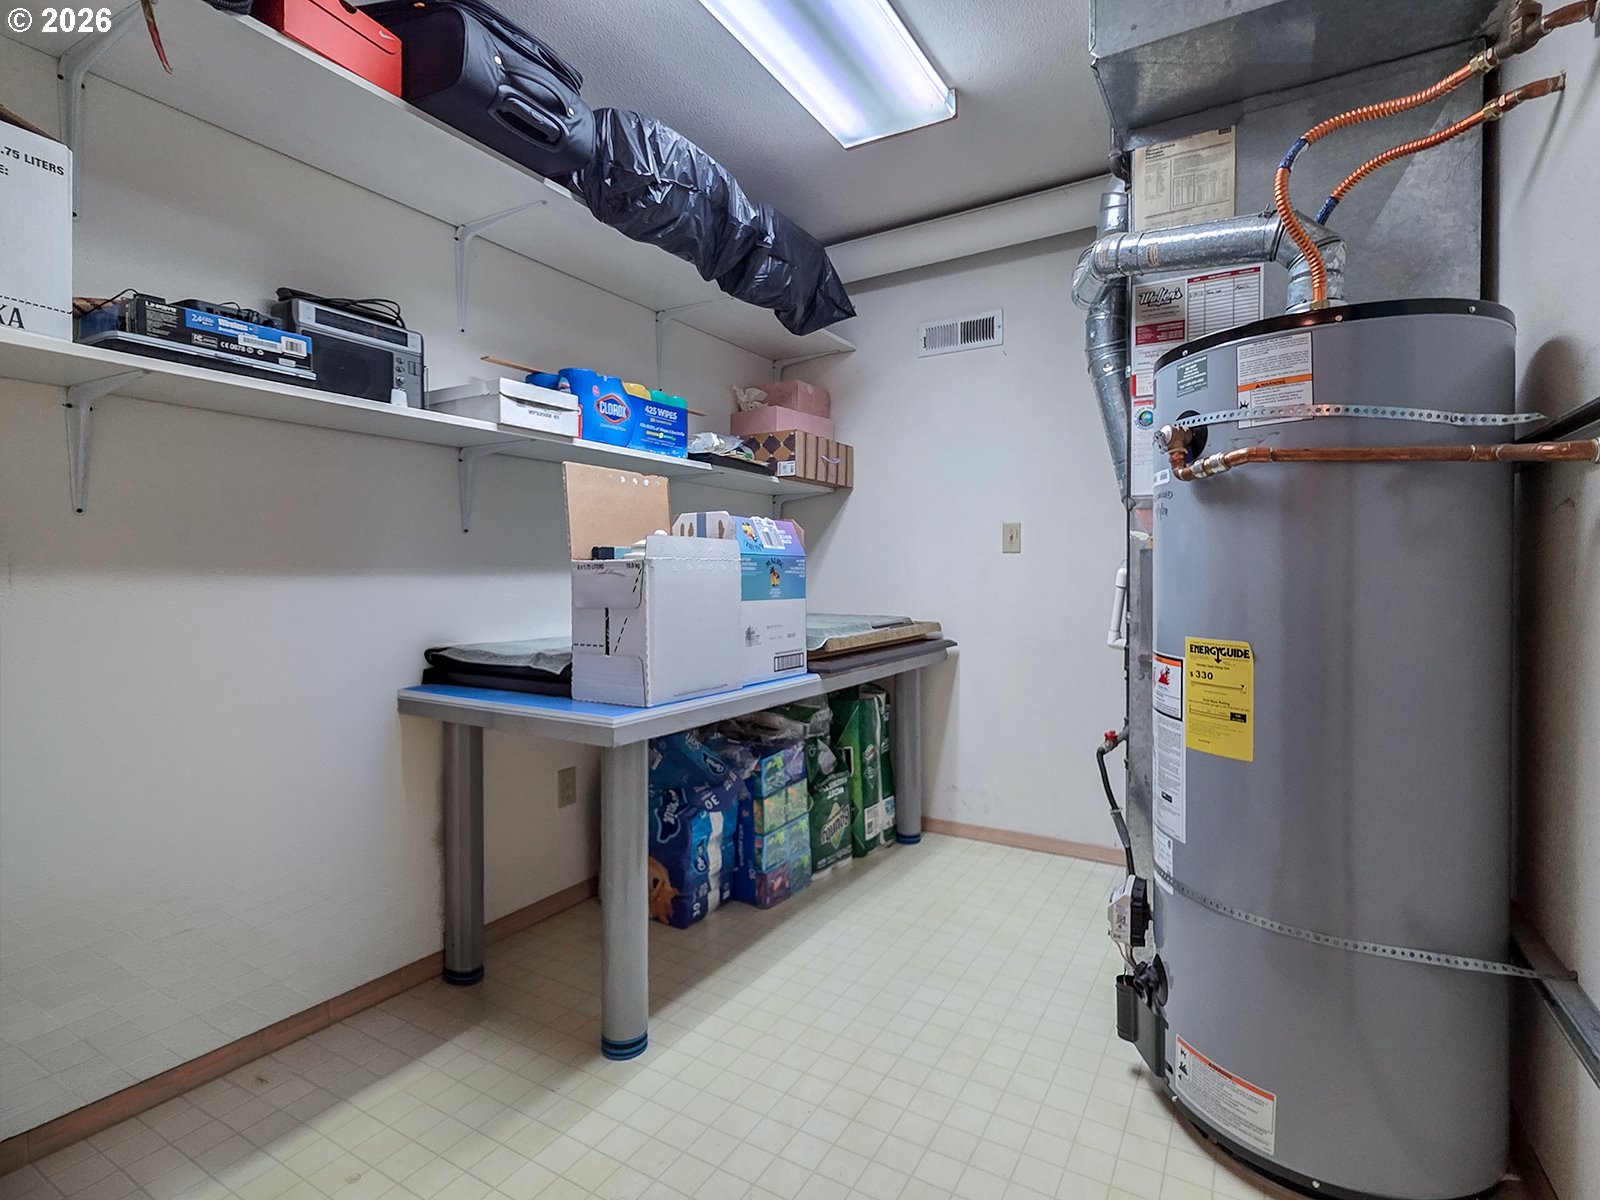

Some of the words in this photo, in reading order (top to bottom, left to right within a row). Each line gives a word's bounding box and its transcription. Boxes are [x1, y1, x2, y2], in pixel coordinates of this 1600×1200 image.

[24, 153, 65, 177] LITERS
[599, 400, 627, 419] CLOROX
[645, 405, 657, 415] 425
[657, 408, 678, 420] WIPES
[1190, 644, 1251, 660] ENERGYGUIDE
[1195, 670, 1214, 680] 330
[705, 794, 720, 810] 30
